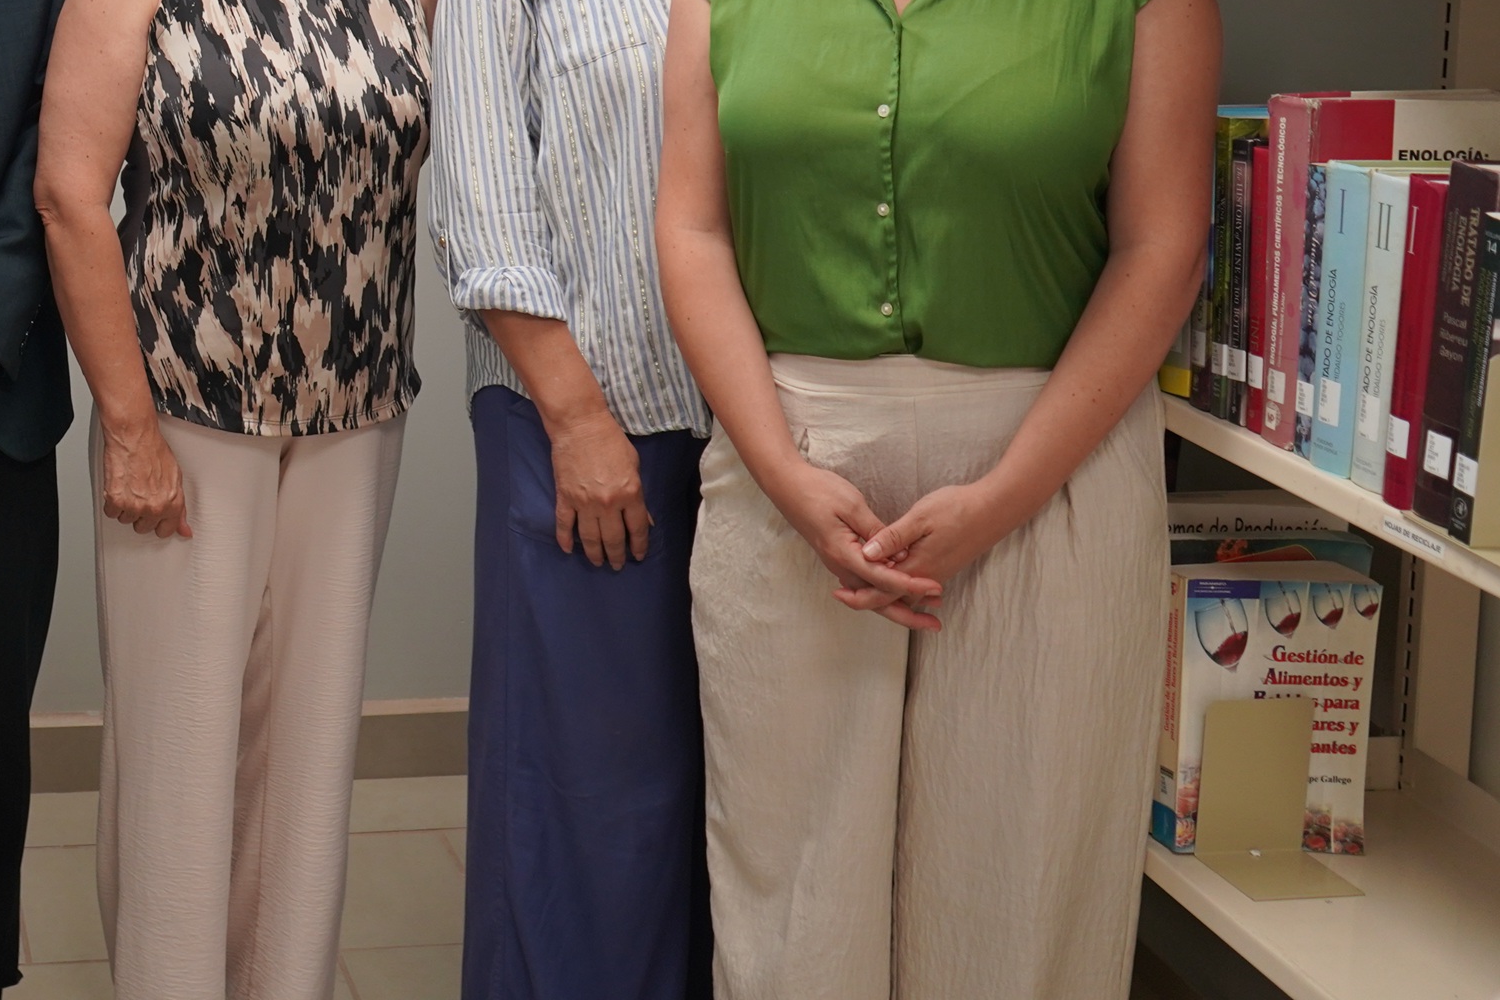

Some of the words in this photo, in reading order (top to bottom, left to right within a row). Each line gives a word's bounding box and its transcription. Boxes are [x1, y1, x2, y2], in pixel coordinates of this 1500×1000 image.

[1276, 116, 1287, 184] TECNOLÓGICOS
[1398, 147, 1490, 161] ENOLOGÍA:
[1234, 182, 1243, 231] HISTORY
[1274, 195, 1283, 249] CIENTÍFICOS
[1234, 242, 1242, 274] WINE
[1463, 207, 1481, 281] TRATADO
[1486, 240, 1497, 254] 14
[1233, 287, 1241, 304] 100
[1271, 250, 1281, 316] FUNDAMENTOS
[1326, 268, 1338, 328] ENOLOGÍA
[1460, 284, 1472, 307] DE
[1337, 300, 1346, 342] TOGORES
[1366, 285, 1379, 345] ENOLOGÍA
[1269, 318, 1278, 365] ENOLOGÍA:
[1324, 330, 1334, 345] DE
[1376, 319, 1386, 360] TOGORES
[1364, 347, 1373, 363] DE
[1385, 520, 1402, 533] HOJAS
[1403, 529, 1410, 538] DE
[1411, 533, 1442, 553] RECICLAJE
[1271, 645, 1339, 665] Gestión
[1344, 650, 1365, 665] de
[1262, 668, 1349, 686] Alimentos
[1351, 676, 1363, 691] y
[1322, 697, 1360, 712] para
[1349, 721, 1359, 736] y
[1319, 774, 1352, 784] Gallego
